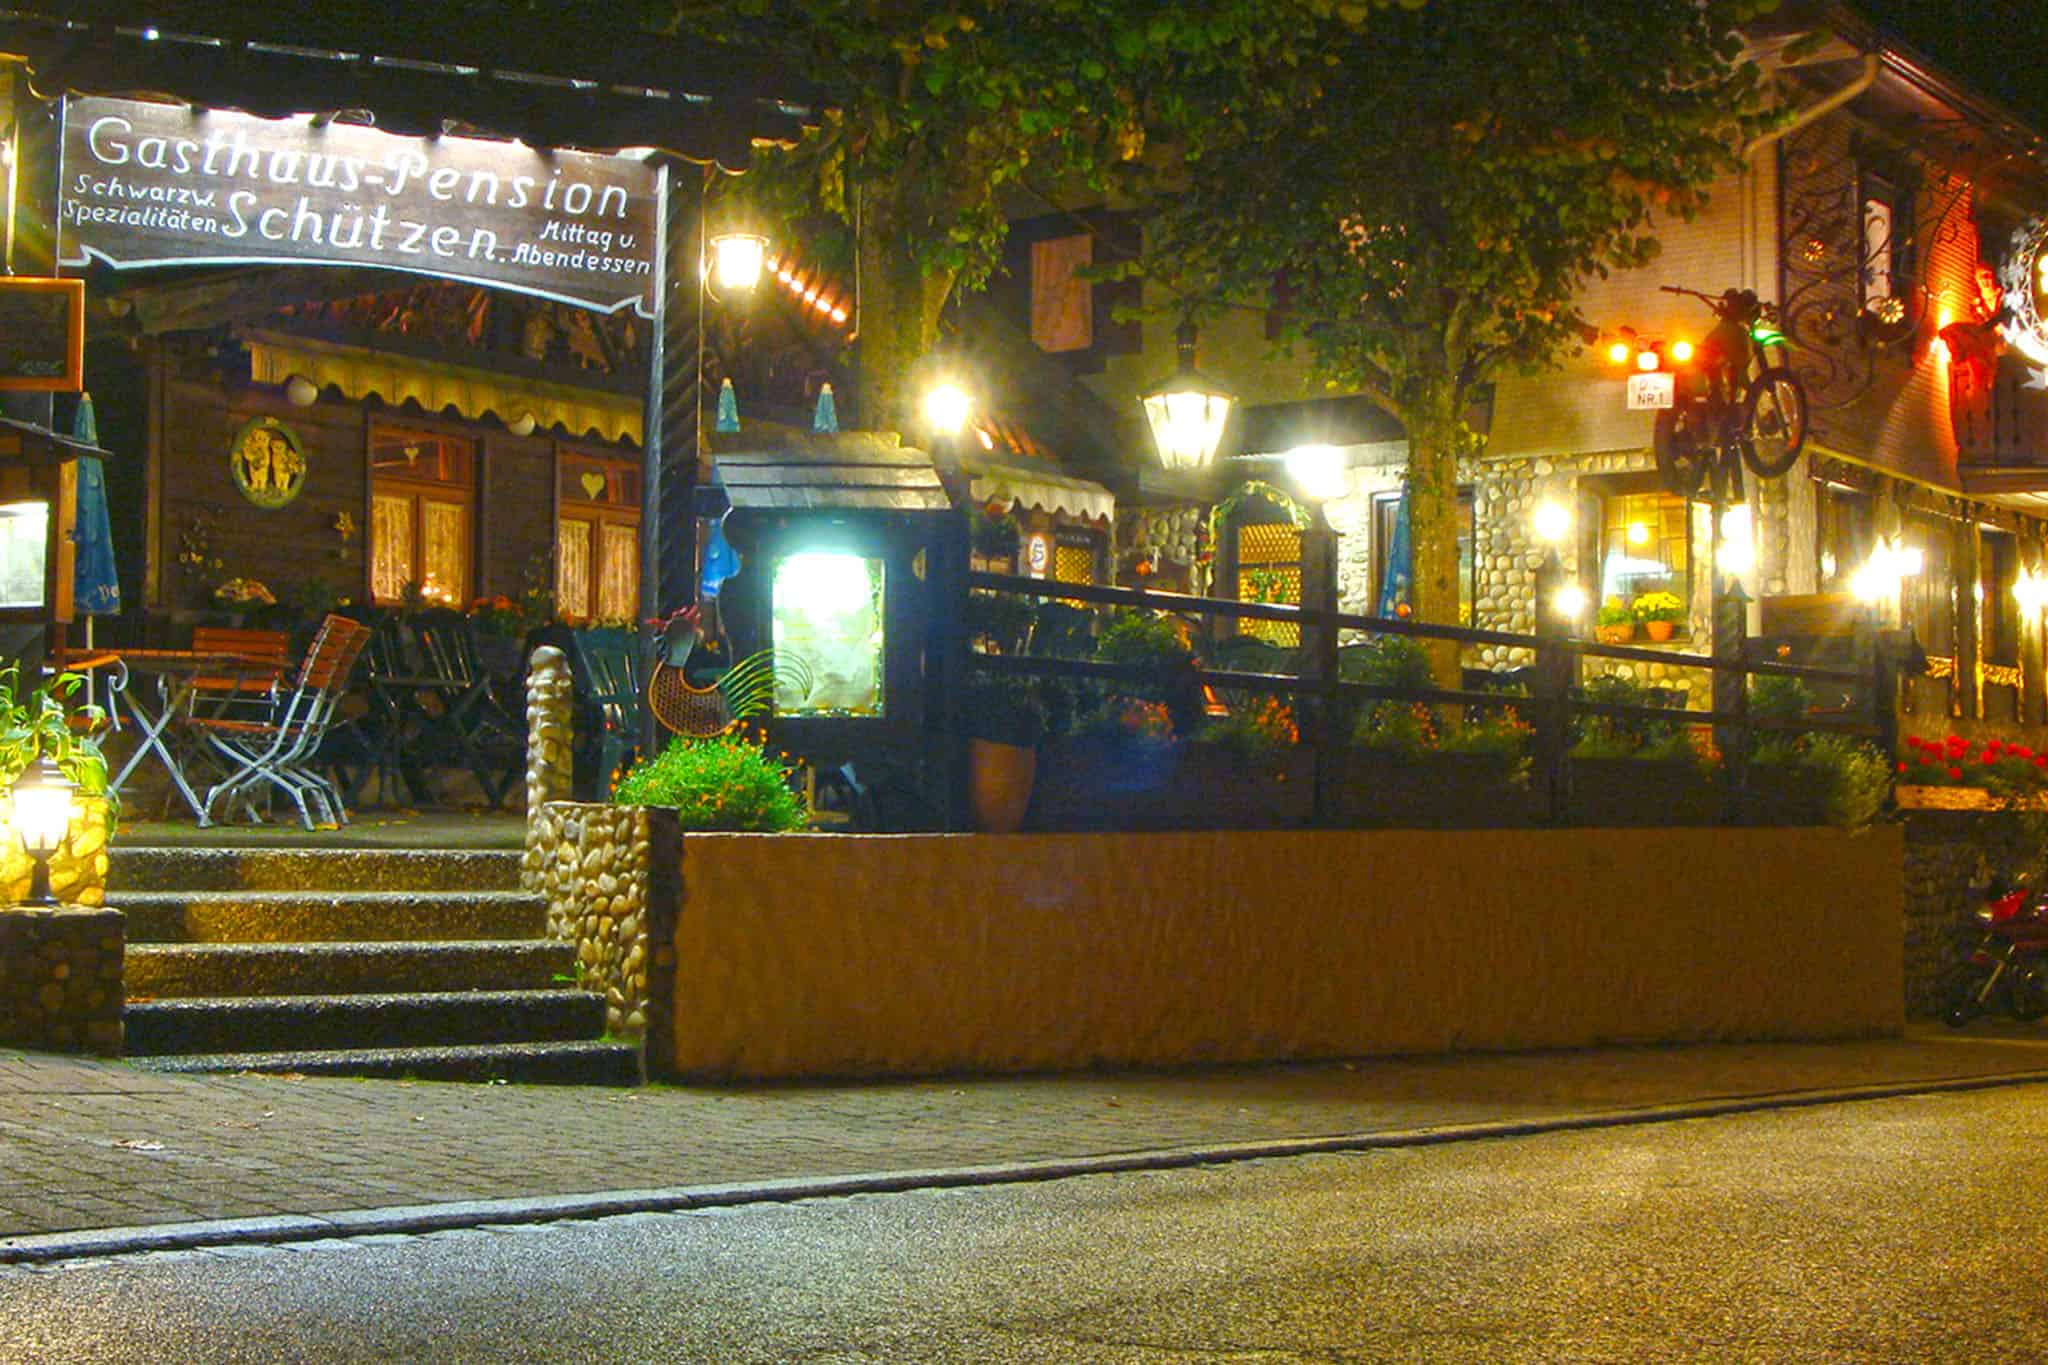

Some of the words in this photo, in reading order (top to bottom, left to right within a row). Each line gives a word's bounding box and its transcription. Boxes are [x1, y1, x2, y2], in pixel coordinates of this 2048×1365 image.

[88, 115, 628, 218] Gasthaus-Pension
[73, 173, 216, 208] Schwarzw.
[63, 199, 217, 233] Spezialitäten
[539, 219, 613, 252] Mittag
[511, 242, 651, 275] Abendessen
